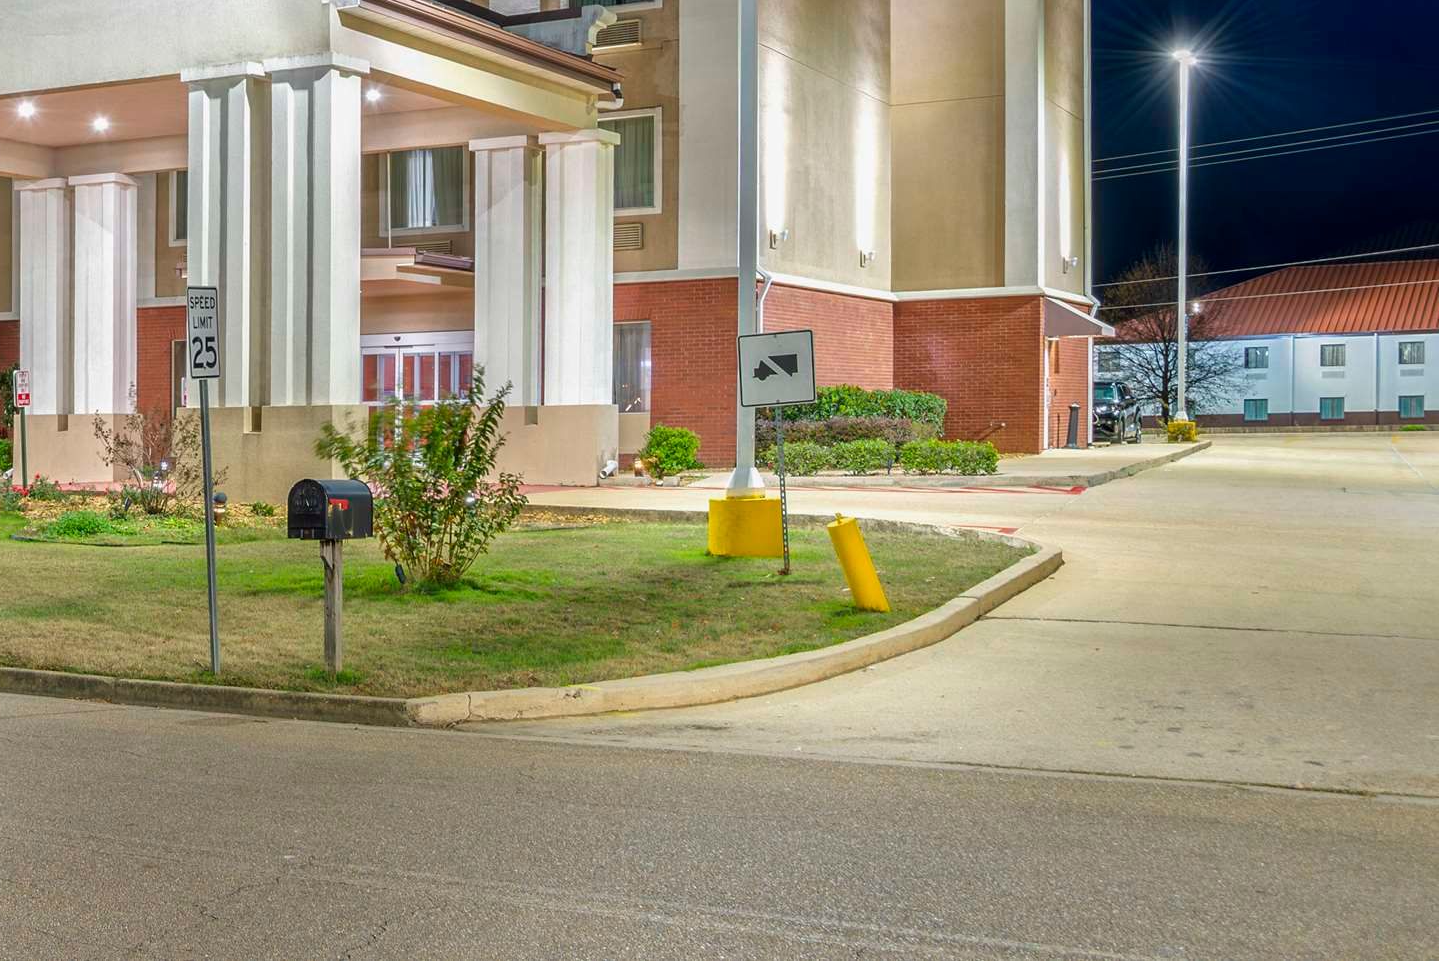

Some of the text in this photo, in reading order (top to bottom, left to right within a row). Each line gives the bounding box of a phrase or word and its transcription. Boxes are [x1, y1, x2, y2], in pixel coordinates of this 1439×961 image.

[190, 296, 216, 309] SPEED
[193, 316, 213, 329] LIMIT
[192, 336, 217, 369] 25
